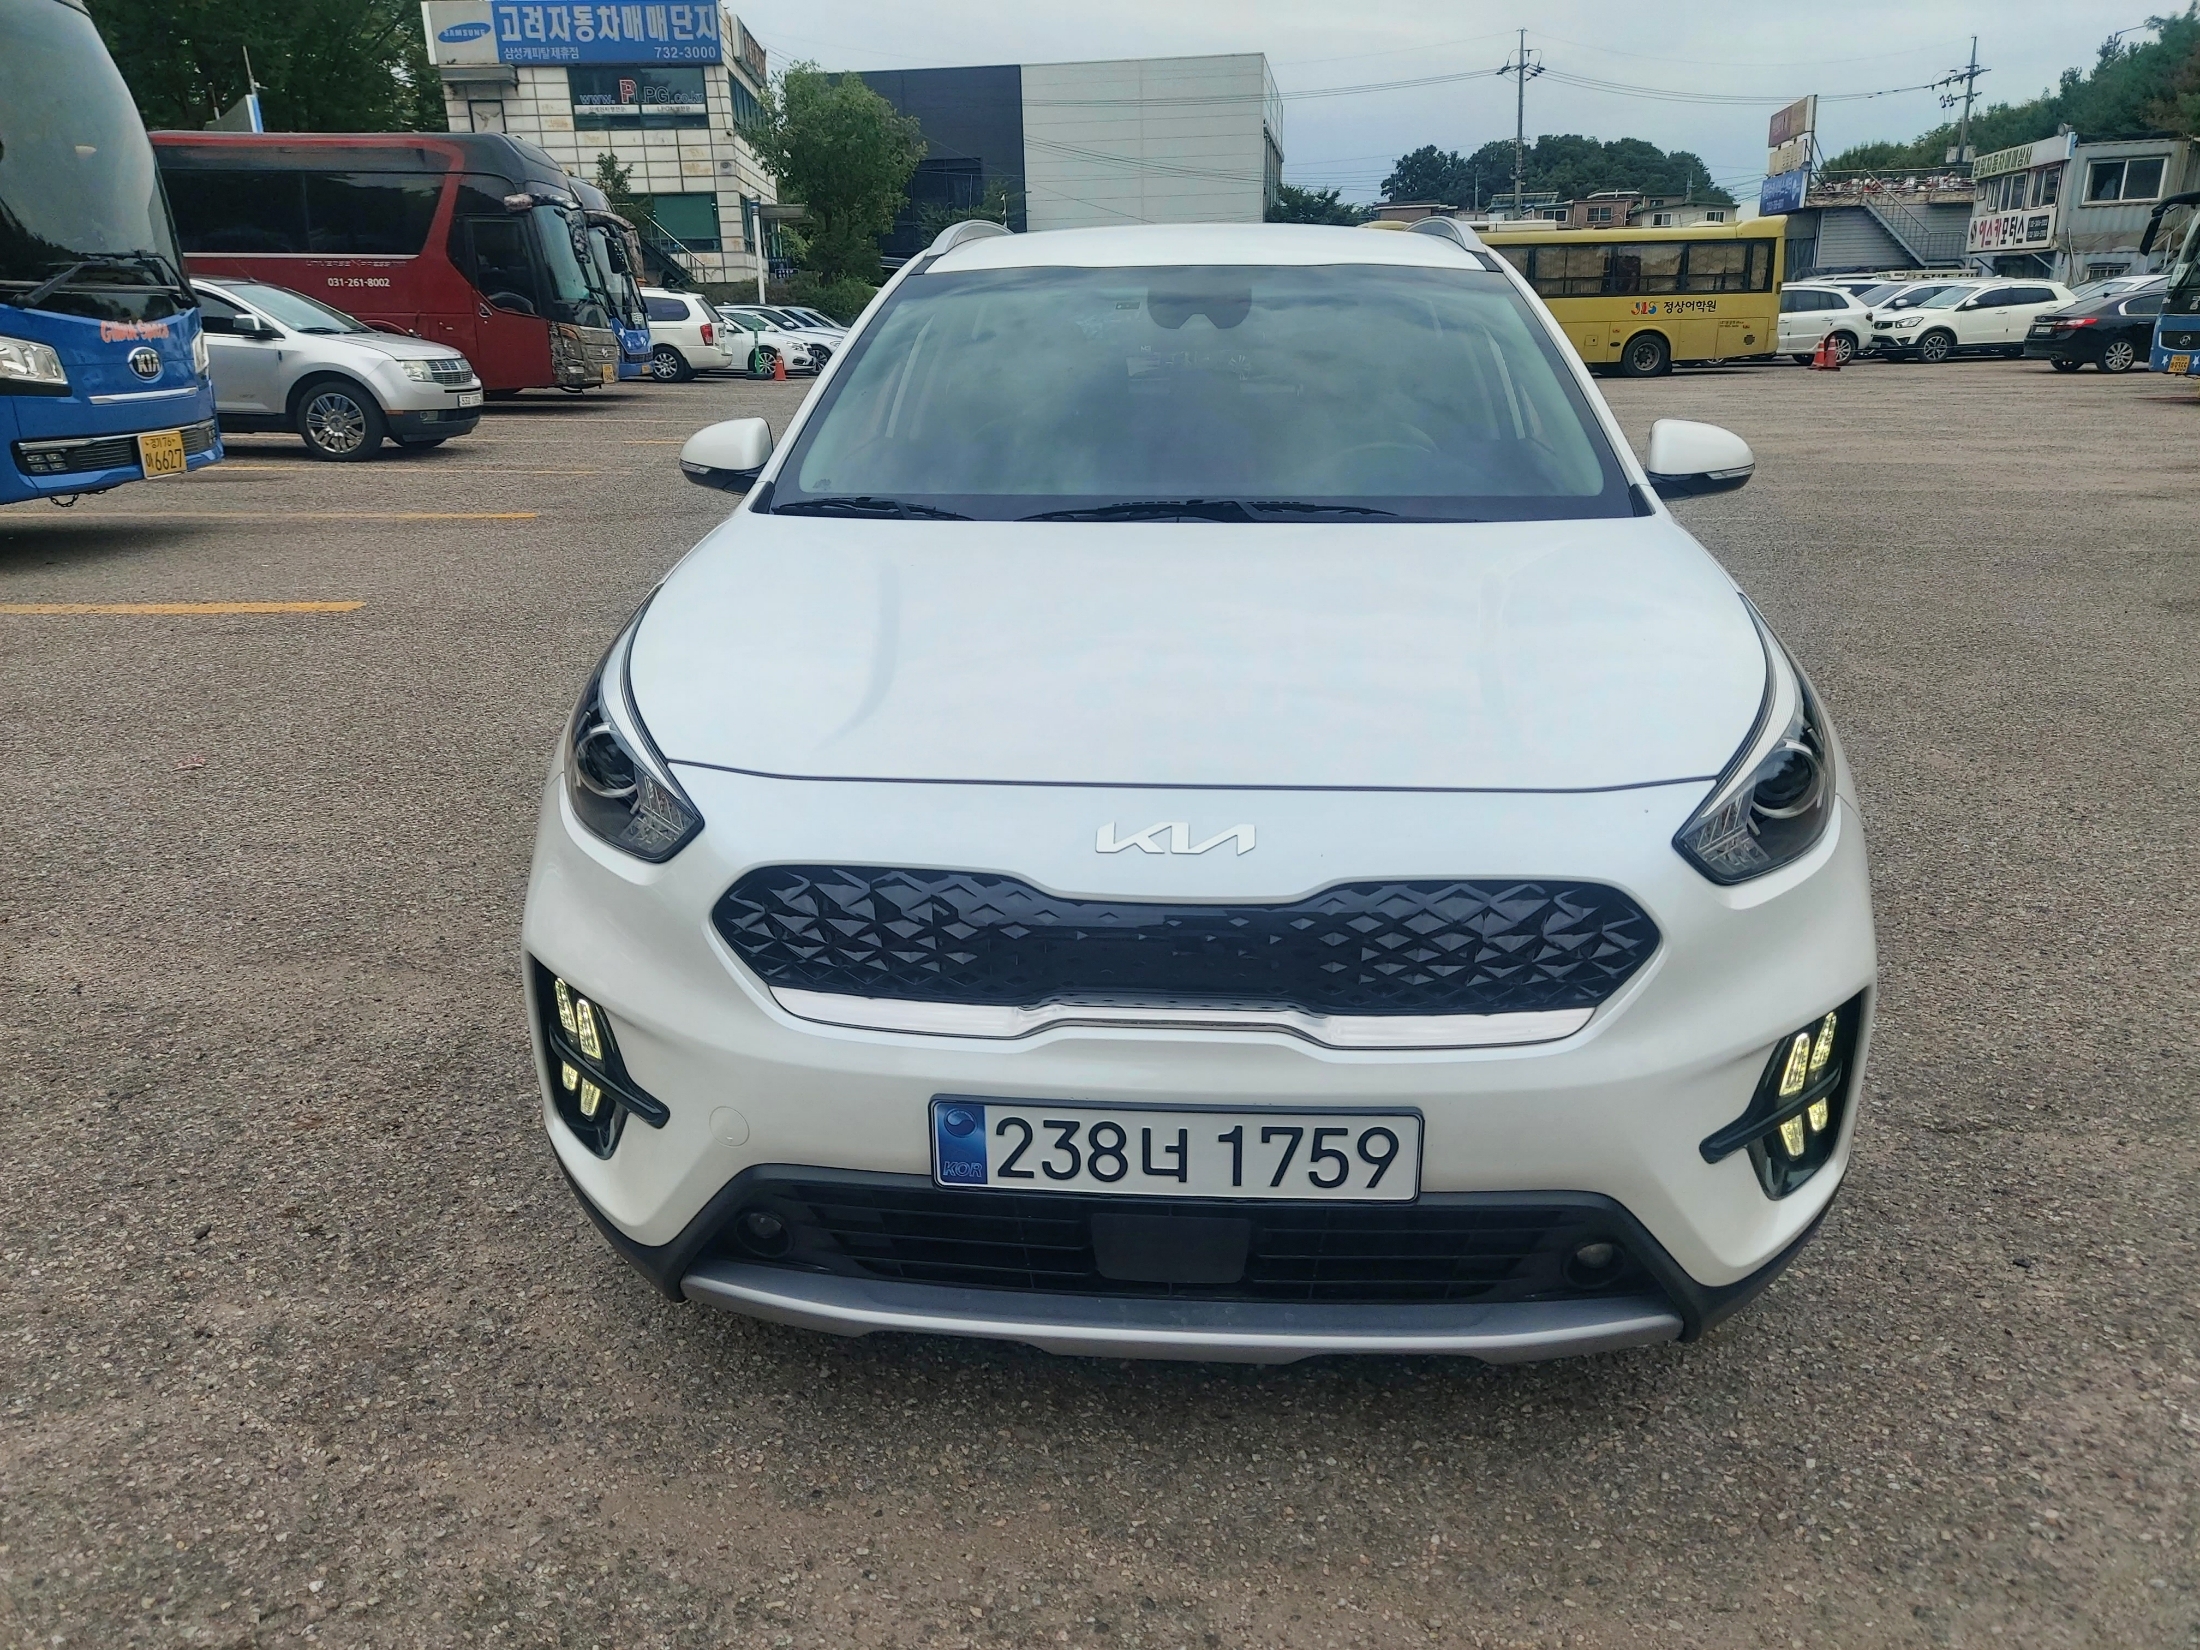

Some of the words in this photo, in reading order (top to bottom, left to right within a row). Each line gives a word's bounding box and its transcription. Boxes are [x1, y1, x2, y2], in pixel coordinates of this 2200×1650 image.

[498, 5, 718, 43] 고려자동차매매단지
[443, 28, 486, 38] SAMSUNG
[654, 46, 717, 59] 732-3000
[327, 278, 390, 287] 031-261-8002
[1663, 300, 1717, 314] 정상어학원
[135, 353, 160, 373] KIA
[1095, 821, 1257, 855] KIA
[995, 1117, 1188, 1183] 238너
[1217, 1124, 1400, 1188] 1759
[942, 1161, 983, 1177] KOR
